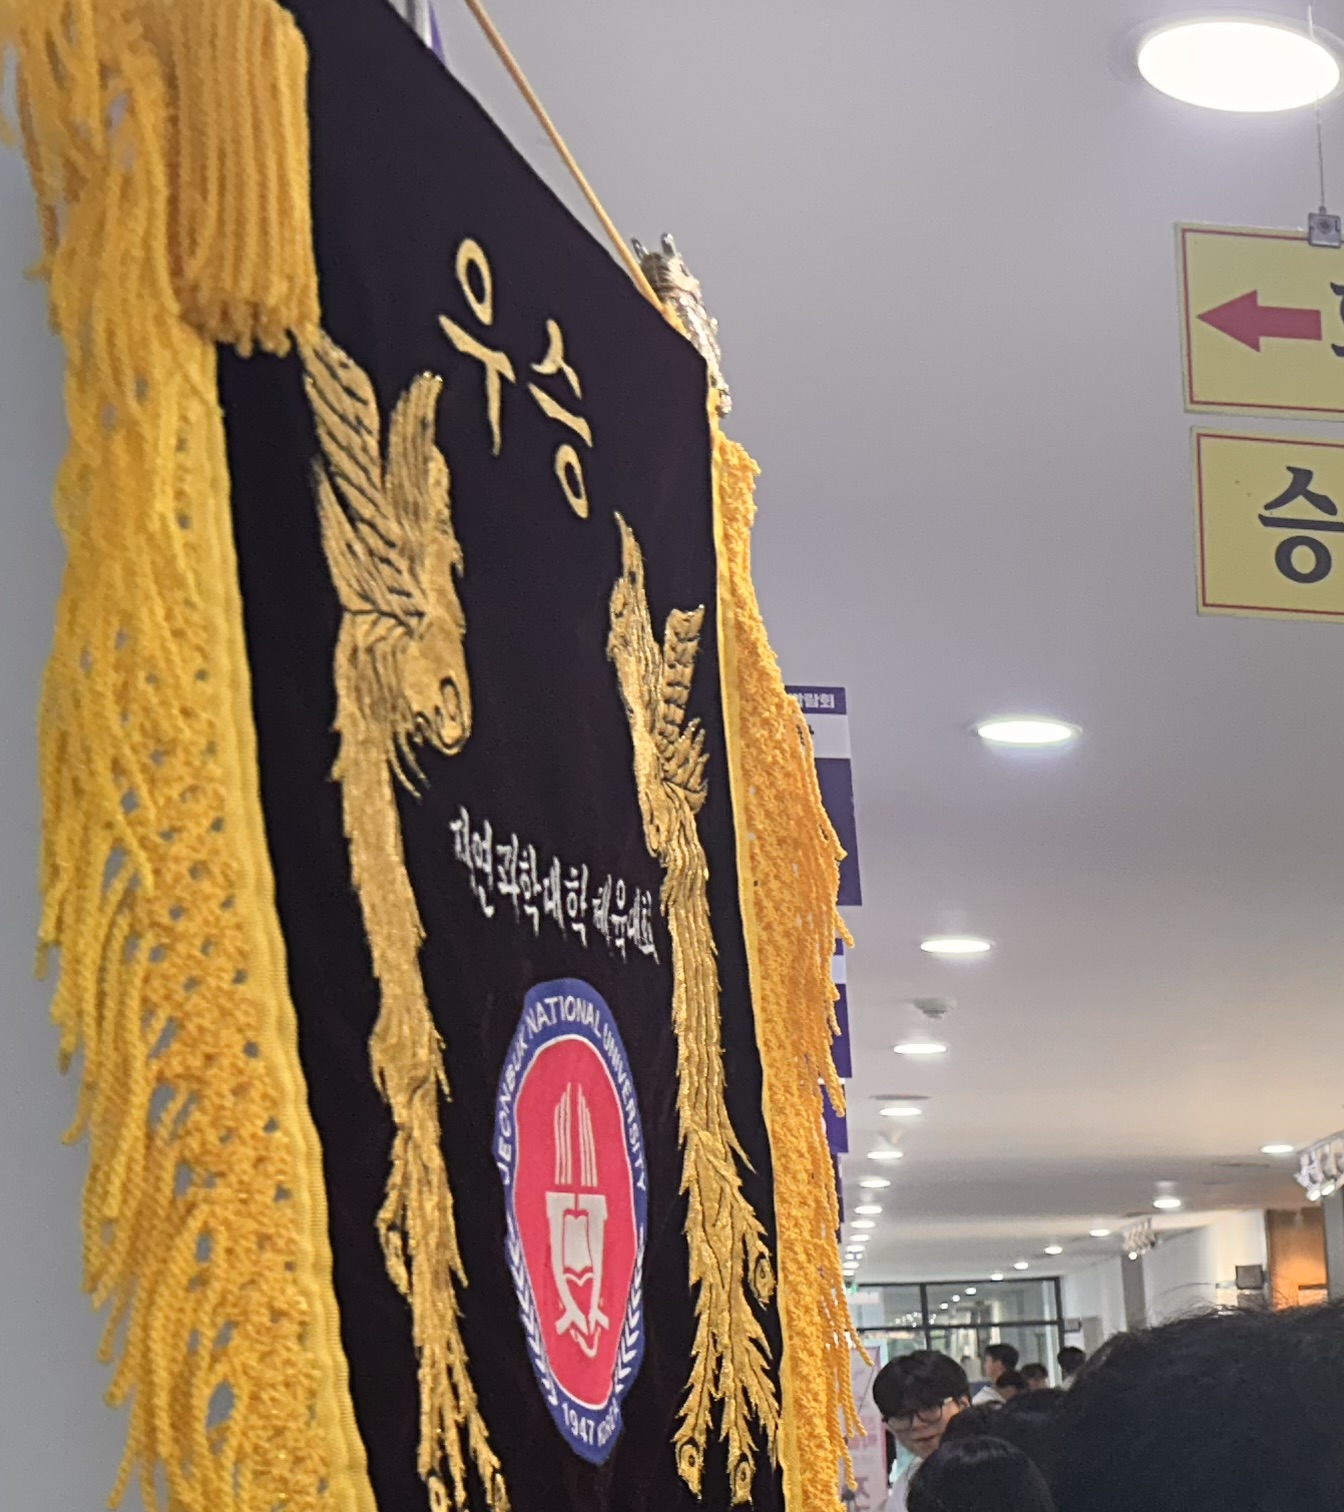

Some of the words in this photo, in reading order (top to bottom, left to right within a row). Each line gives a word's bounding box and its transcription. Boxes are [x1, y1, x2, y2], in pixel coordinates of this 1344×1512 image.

[439, 237, 593, 519] 우승
[525, 995, 602, 1039] NATIONAL
[602, 1022, 646, 1192] UNIVERSITY
[562, 1402, 596, 1446] 1947
